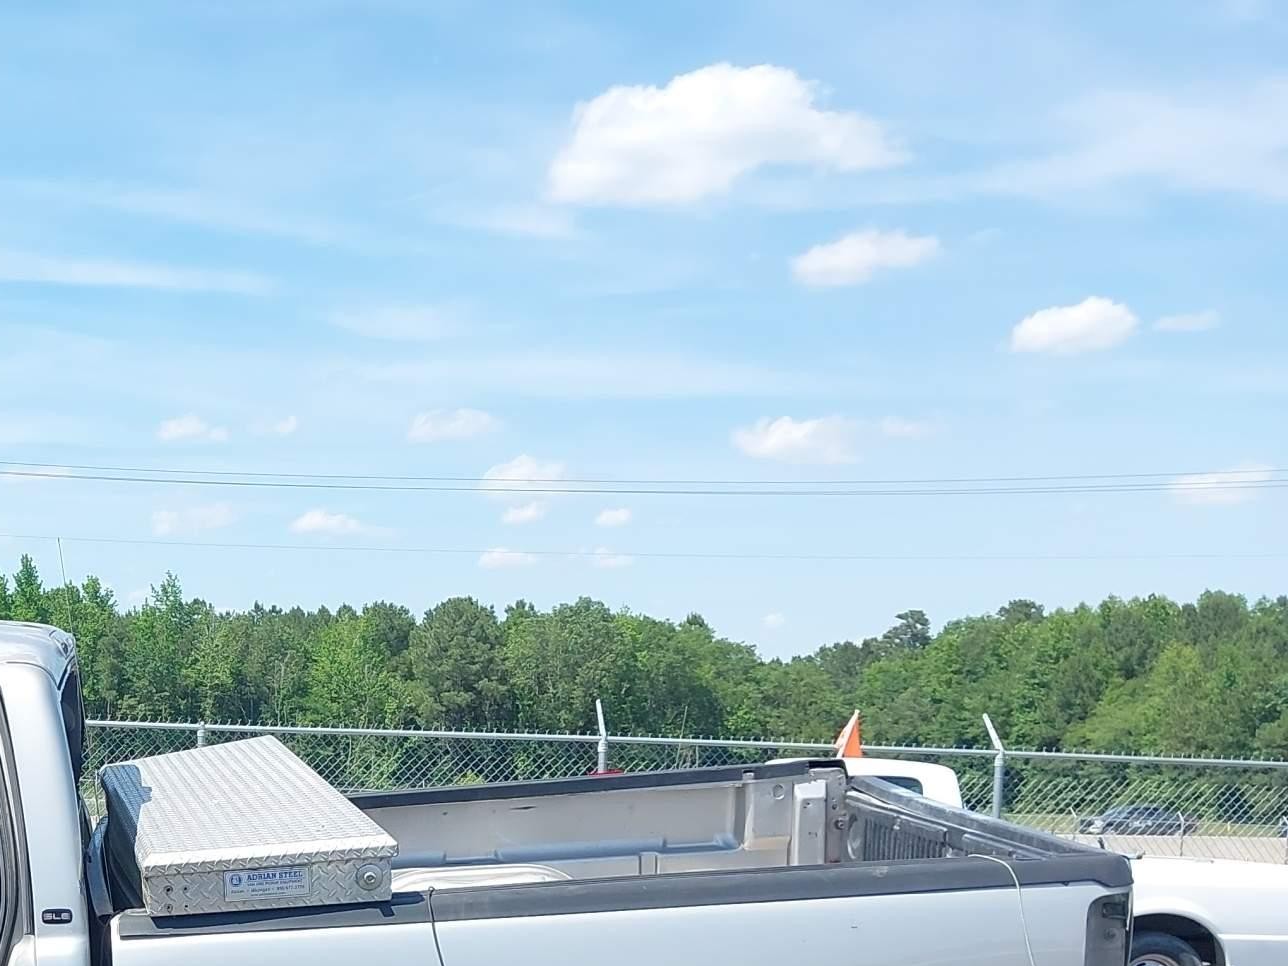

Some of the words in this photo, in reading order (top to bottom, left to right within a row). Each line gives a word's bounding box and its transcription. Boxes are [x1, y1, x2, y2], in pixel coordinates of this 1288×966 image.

[247, 873, 277, 881] ADRIAN
[278, 871, 303, 879] STEEL
[43, 912, 71, 921] SLE
